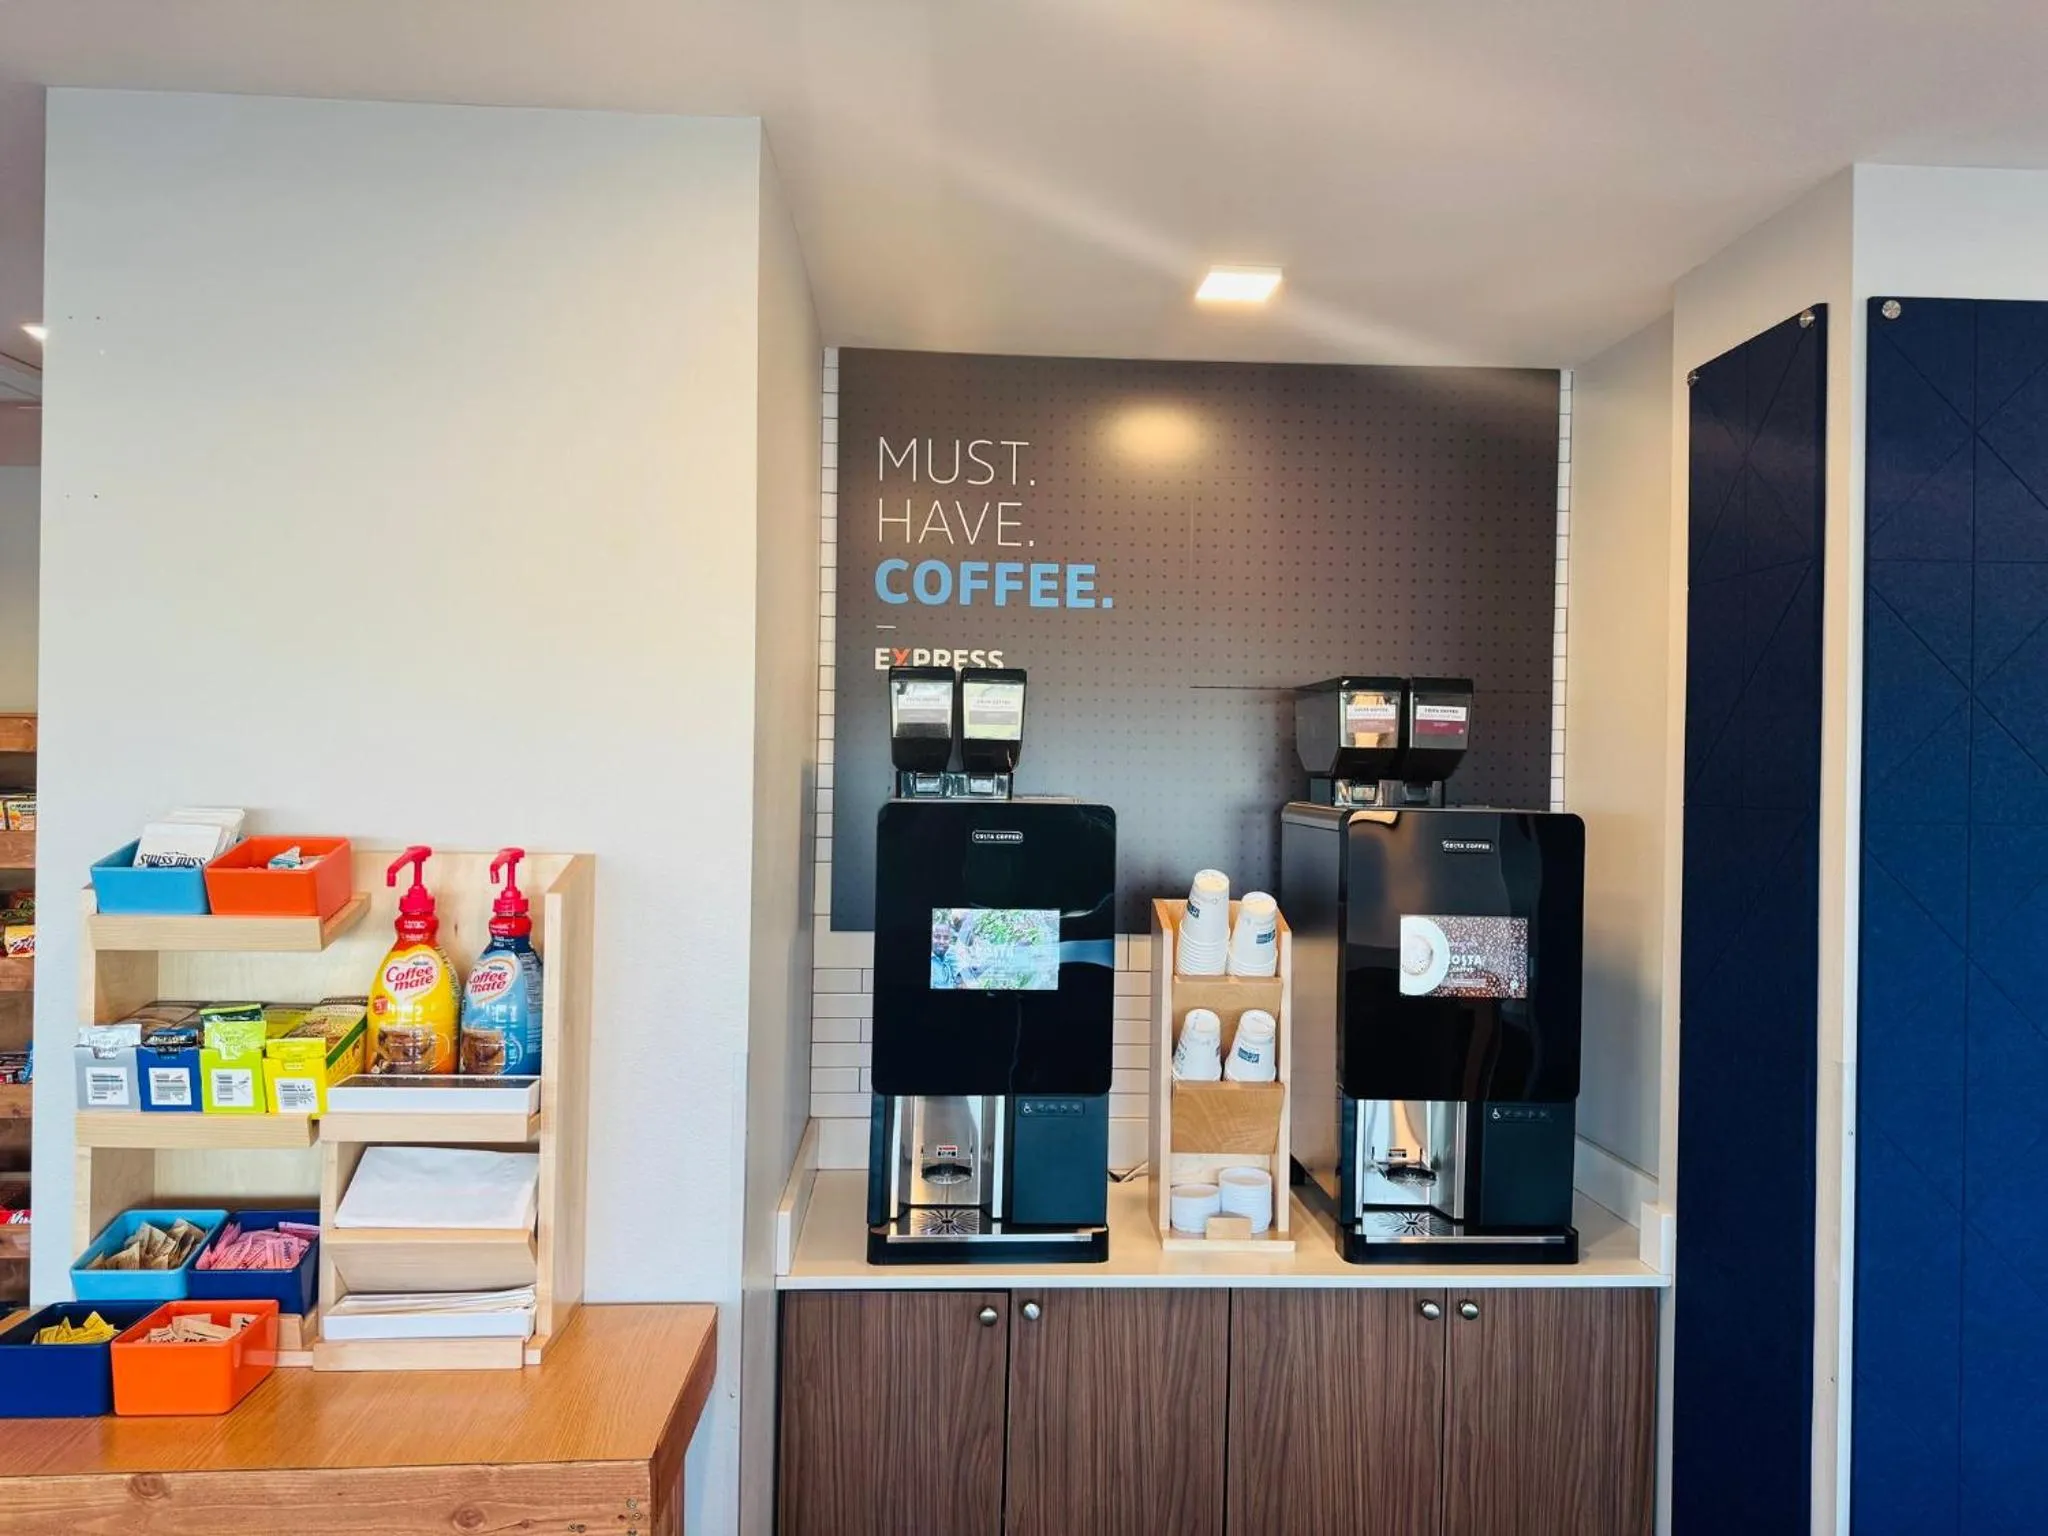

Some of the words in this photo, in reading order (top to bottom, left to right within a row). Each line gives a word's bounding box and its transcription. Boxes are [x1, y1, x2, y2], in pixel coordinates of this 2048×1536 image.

[878, 436, 1036, 487] MUST.
[878, 497, 1035, 547] HAVE.
[874, 558, 1113, 609] COFFEE.
[874, 647, 1005, 670] EXPRESS
[1451, 954, 1483, 967] OSTA
[386, 965, 434, 983] Coffee
[394, 974, 434, 992] mate
[469, 968, 509, 984] Coffee
[470, 976, 508, 994] mate
